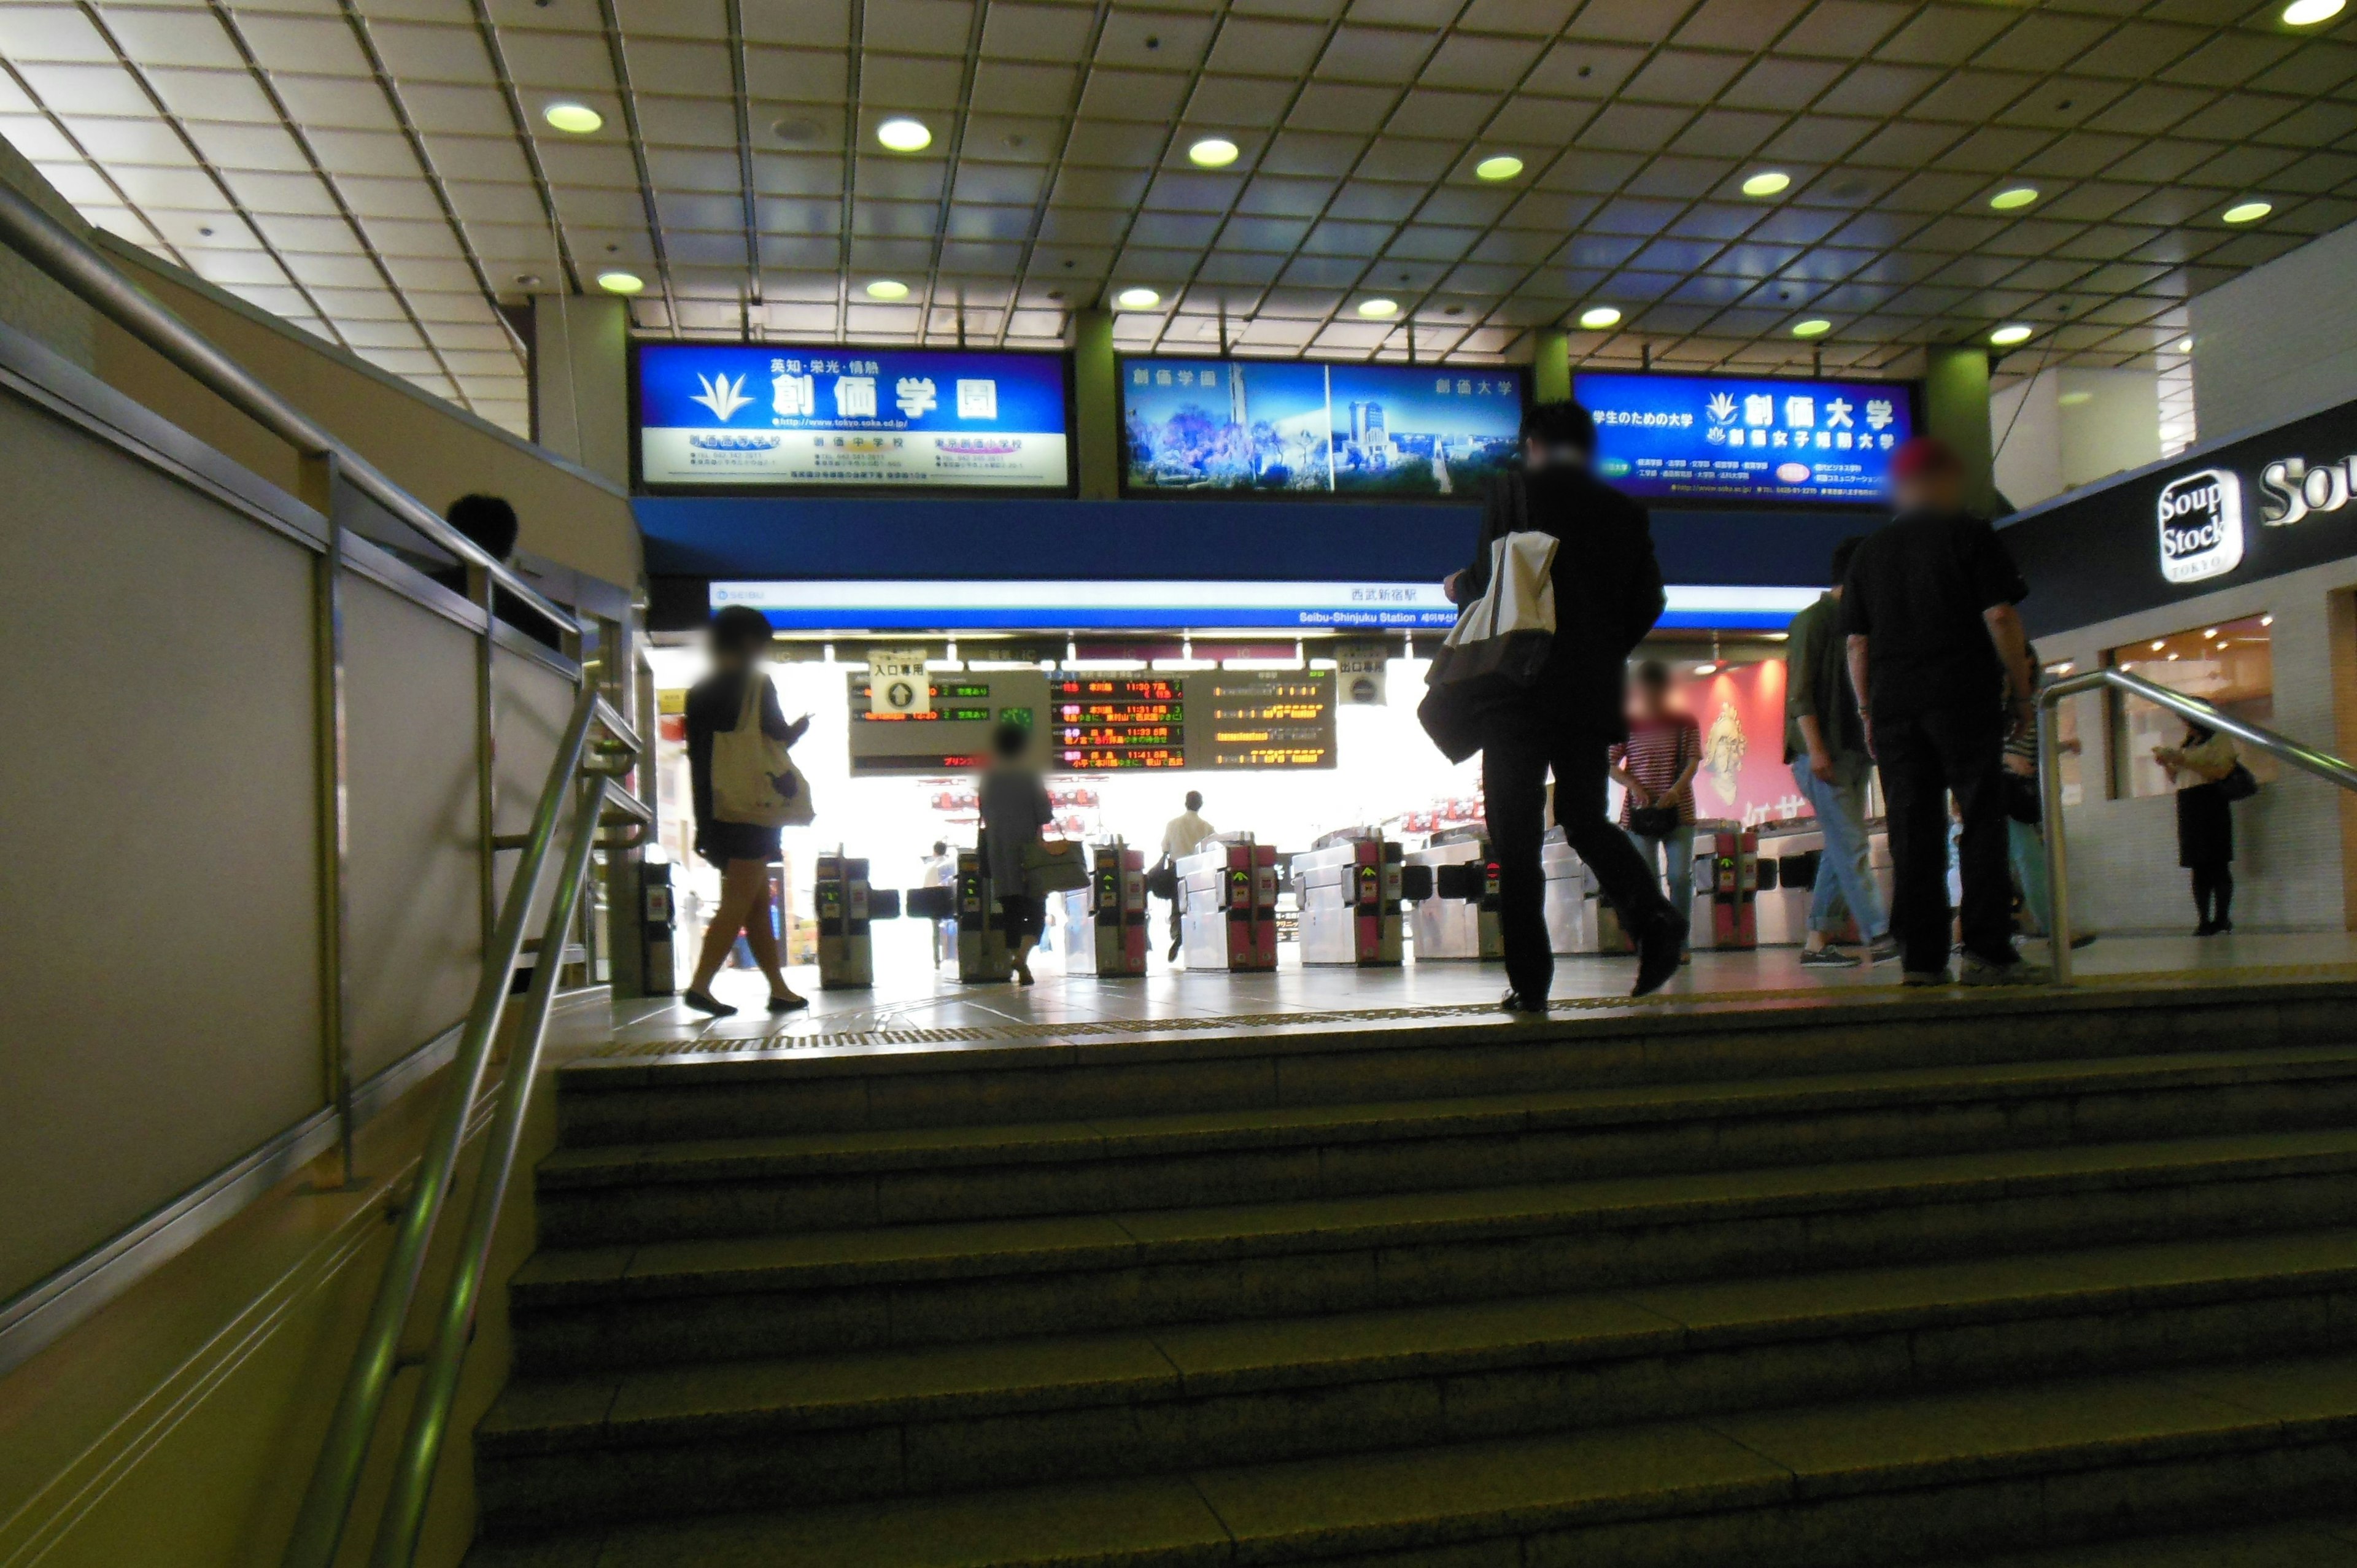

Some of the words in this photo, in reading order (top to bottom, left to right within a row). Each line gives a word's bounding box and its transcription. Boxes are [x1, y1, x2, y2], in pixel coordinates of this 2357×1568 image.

[1133, 368, 1215, 387] 創価学園
[1436, 378, 1512, 395] 創価大学
[772, 374, 997, 419] 創価学園
[1593, 409, 1693, 427] 学生のための大学
[1744, 393, 1893, 430] 創価大学
[1728, 428, 1894, 450] 創価女子短期大学
[2161, 483, 2222, 520] Soup
[2162, 514, 2224, 557] Stock
[2171, 556, 2221, 579] TOKYO
[1352, 588, 1417, 601] 西武新宿駅
[1299, 612, 1377, 624] Seibu-Shinjuku
[1380, 612, 1416, 622] Station
[875, 663, 923, 676] 入口専用
[1126, 682, 1150, 691] 11:30
[1127, 705, 1150, 714] 11:31
